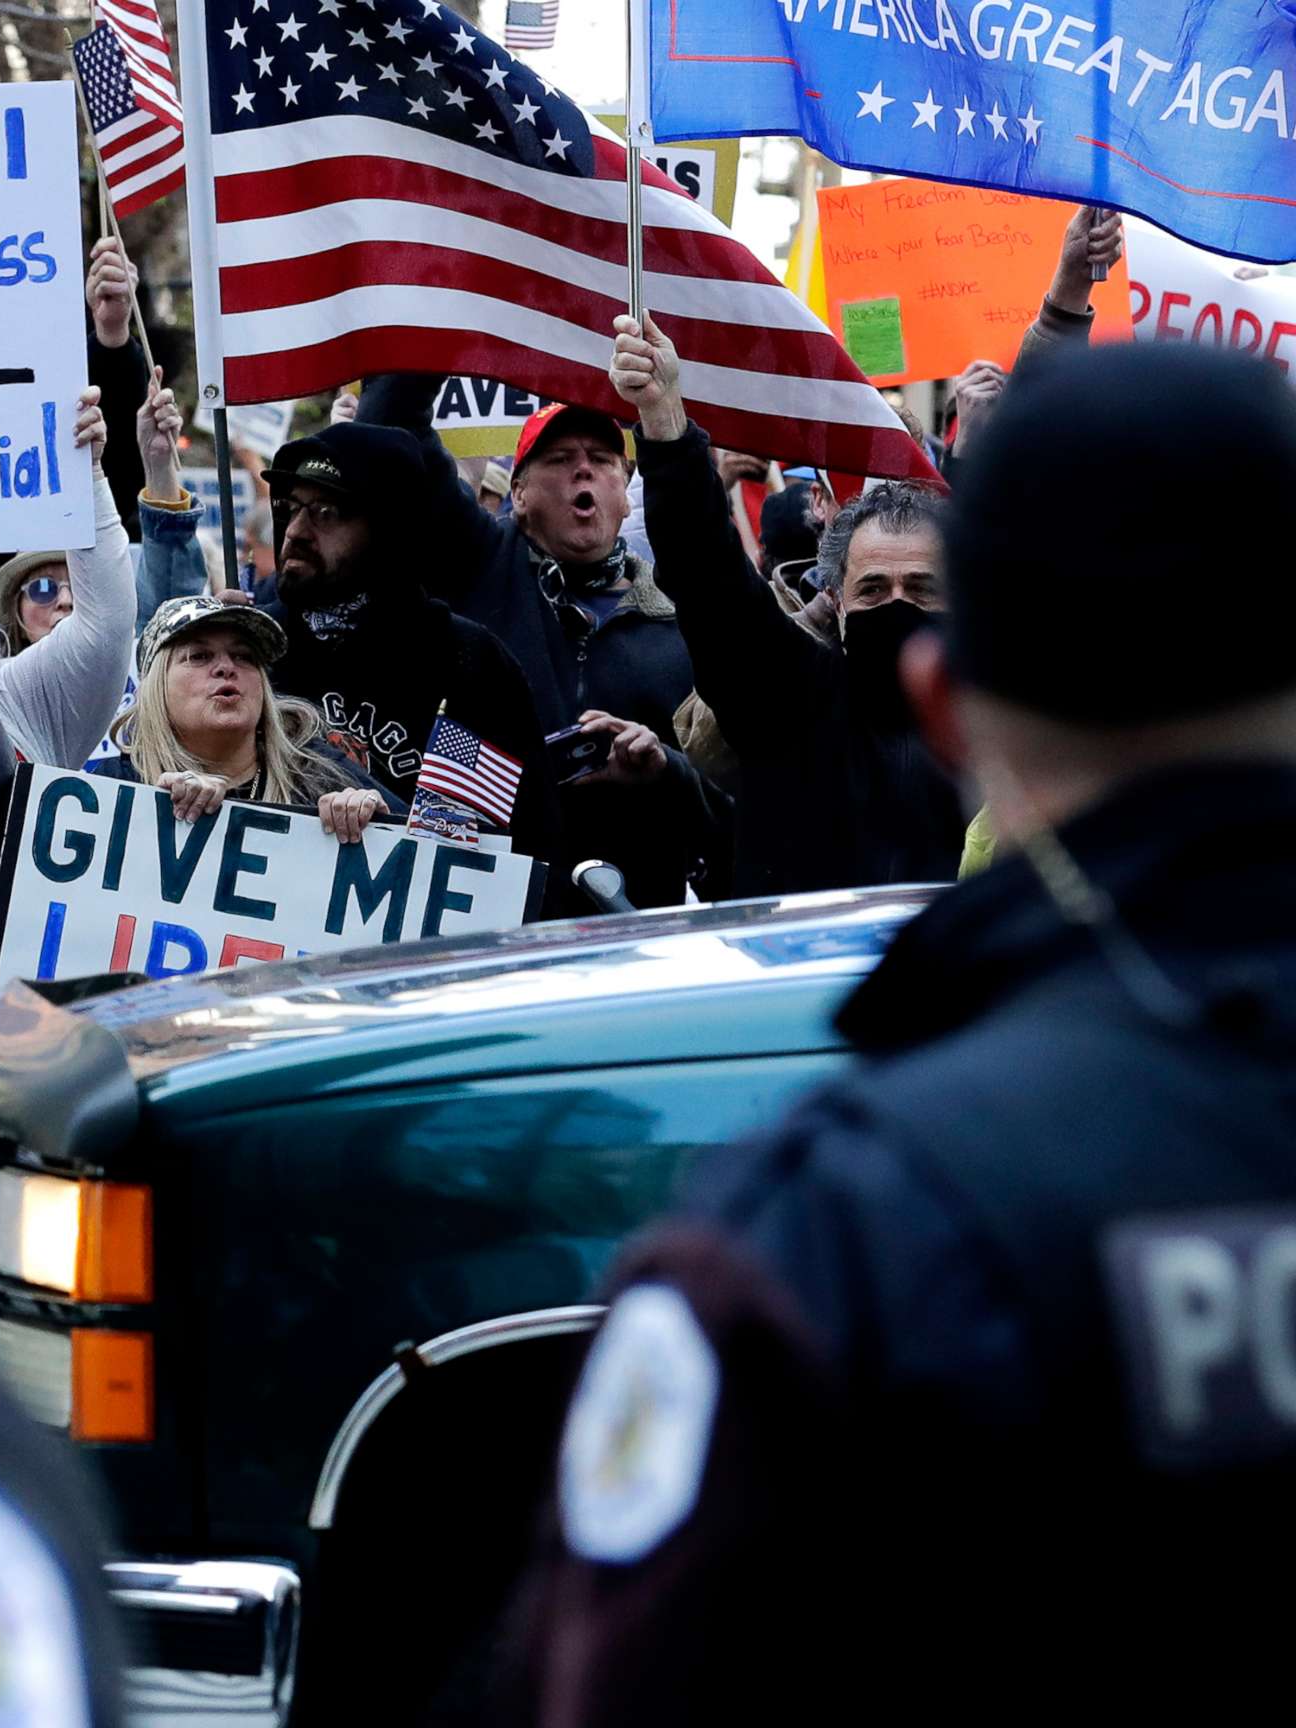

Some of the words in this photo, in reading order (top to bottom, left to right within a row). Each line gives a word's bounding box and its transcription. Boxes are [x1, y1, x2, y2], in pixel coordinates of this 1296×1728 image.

[780, 0, 967, 55] MERICA
[968, 0, 1173, 108] GREAT
[1160, 60, 1296, 142] AGA
[32, 776, 292, 921] GIVE
[324, 840, 496, 945] ME
